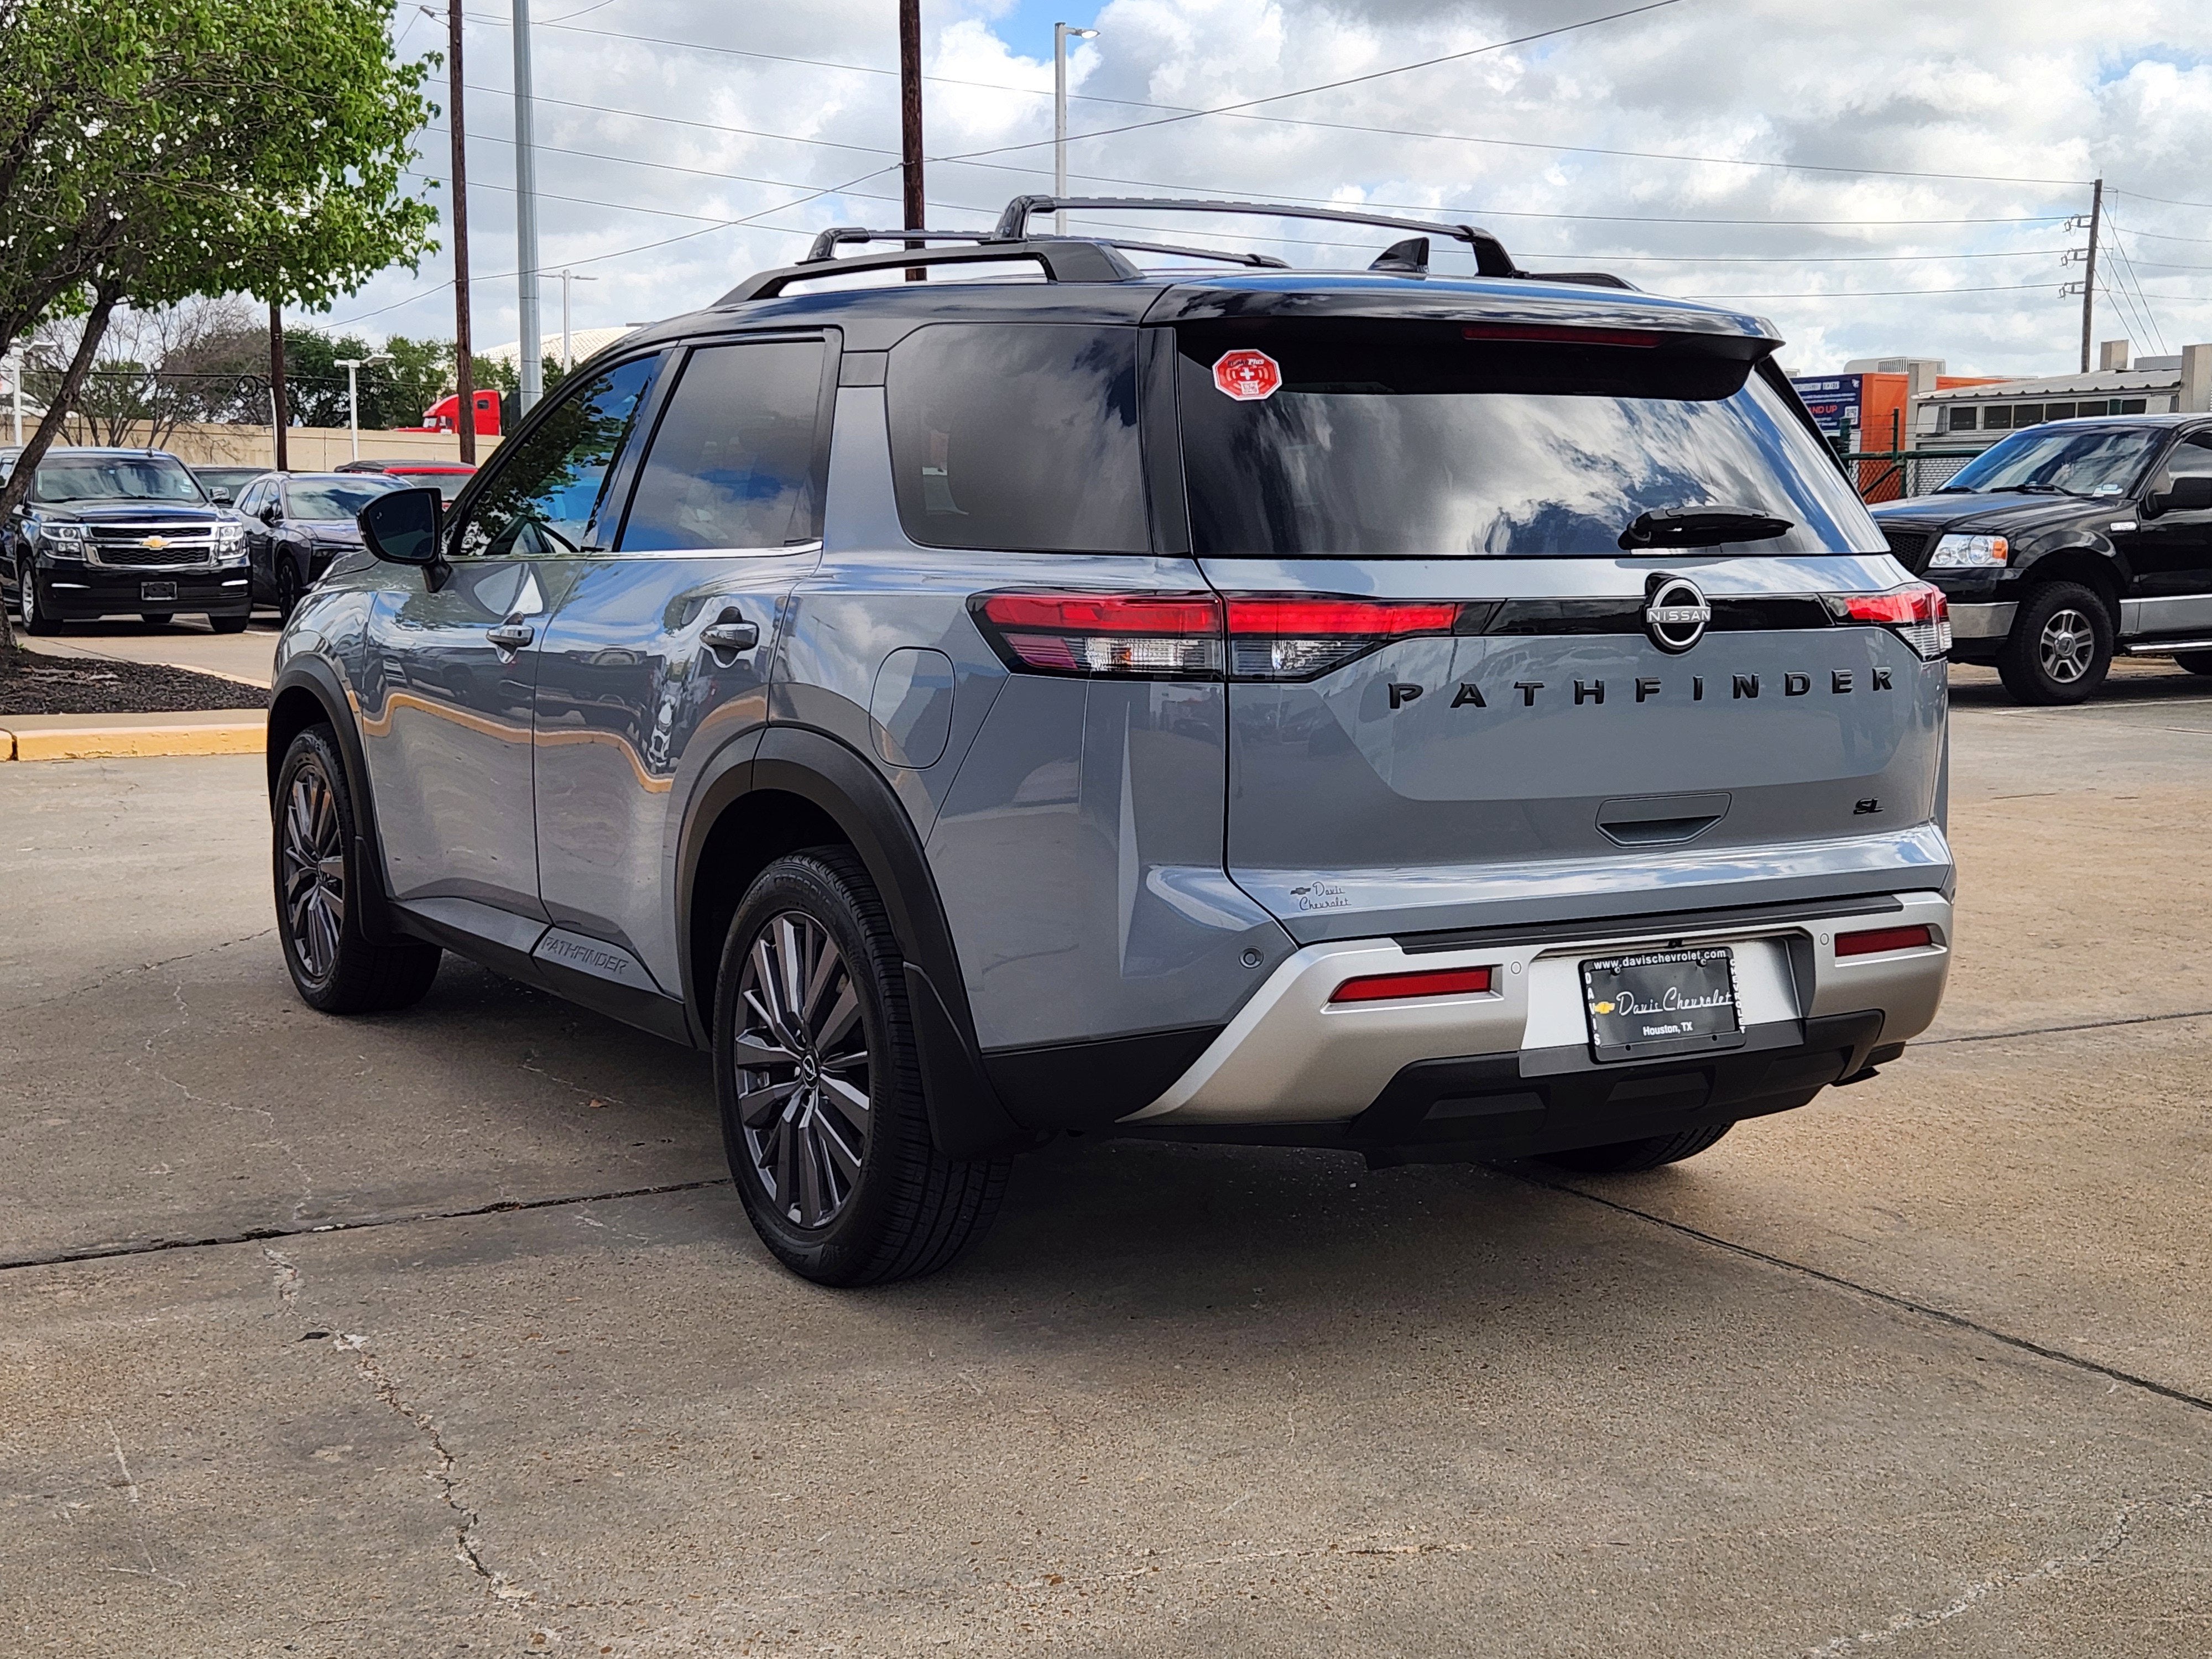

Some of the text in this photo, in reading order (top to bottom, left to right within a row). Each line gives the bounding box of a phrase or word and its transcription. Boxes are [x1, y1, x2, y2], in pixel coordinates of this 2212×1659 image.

[1827, 405, 1838, 413] UP
[1648, 610, 1710, 621] NISSAN
[1389, 666, 1893, 709] PATHFINDER
[1853, 797, 1884, 815] SL
[1312, 881, 1345, 896] Davis
[1299, 896, 1352, 910] Chevrolet
[541, 936, 629, 974] PATHFINDER
[1594, 950, 1726, 969] www.davischevrolet.com
[1616, 987, 1733, 1016] Davis Chevrolet
[1730, 959, 1746, 1034] CHEVROLET
[1584, 972, 1600, 1046] DAVIS
[1643, 1021, 1693, 1036] Houston, TX
